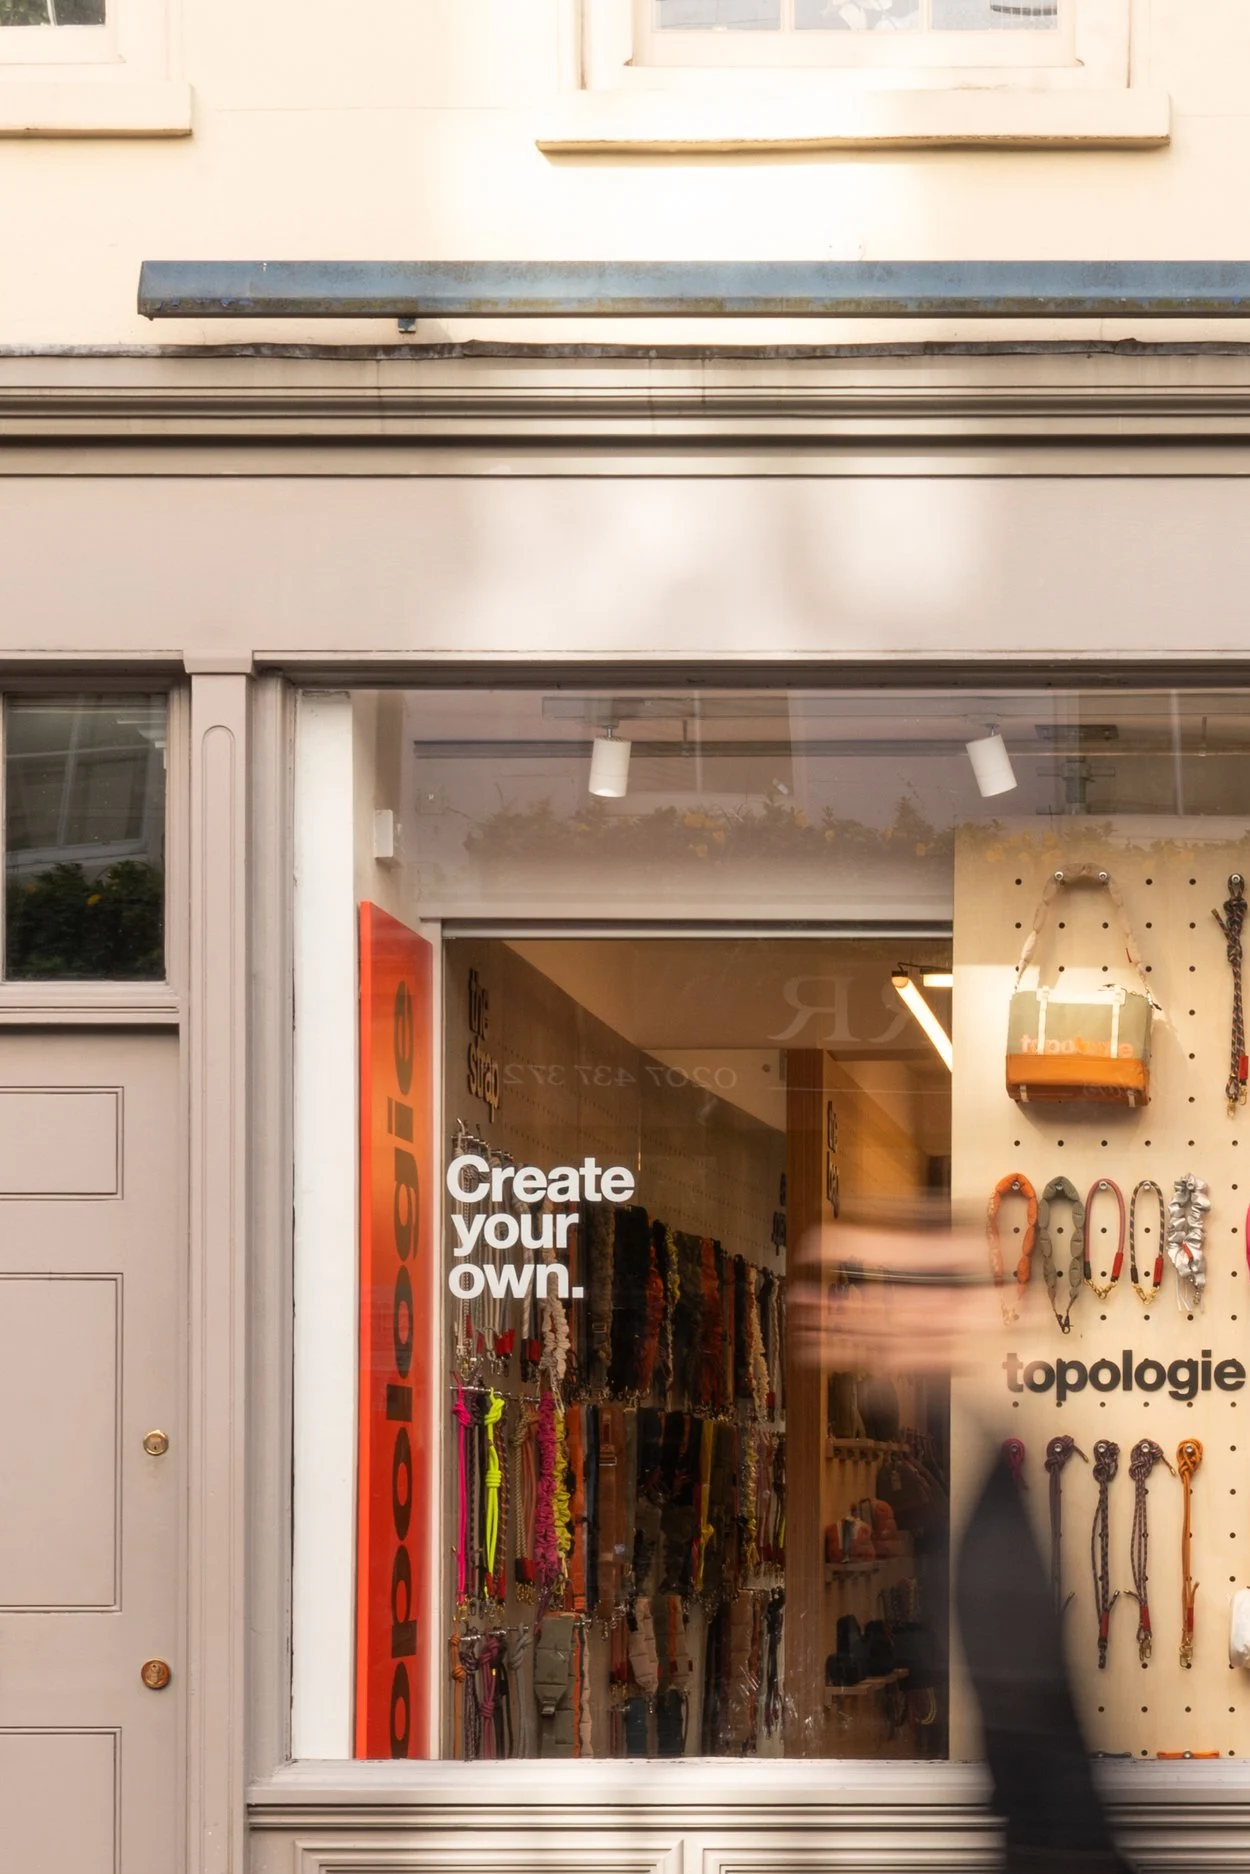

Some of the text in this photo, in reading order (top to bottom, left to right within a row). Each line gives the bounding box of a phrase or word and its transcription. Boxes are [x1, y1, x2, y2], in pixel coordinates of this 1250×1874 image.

[446, 1154, 636, 1203] Create
[451, 1213, 580, 1257] your
[448, 1263, 585, 1299] own.
[1002, 1349, 1247, 1401] topologie
